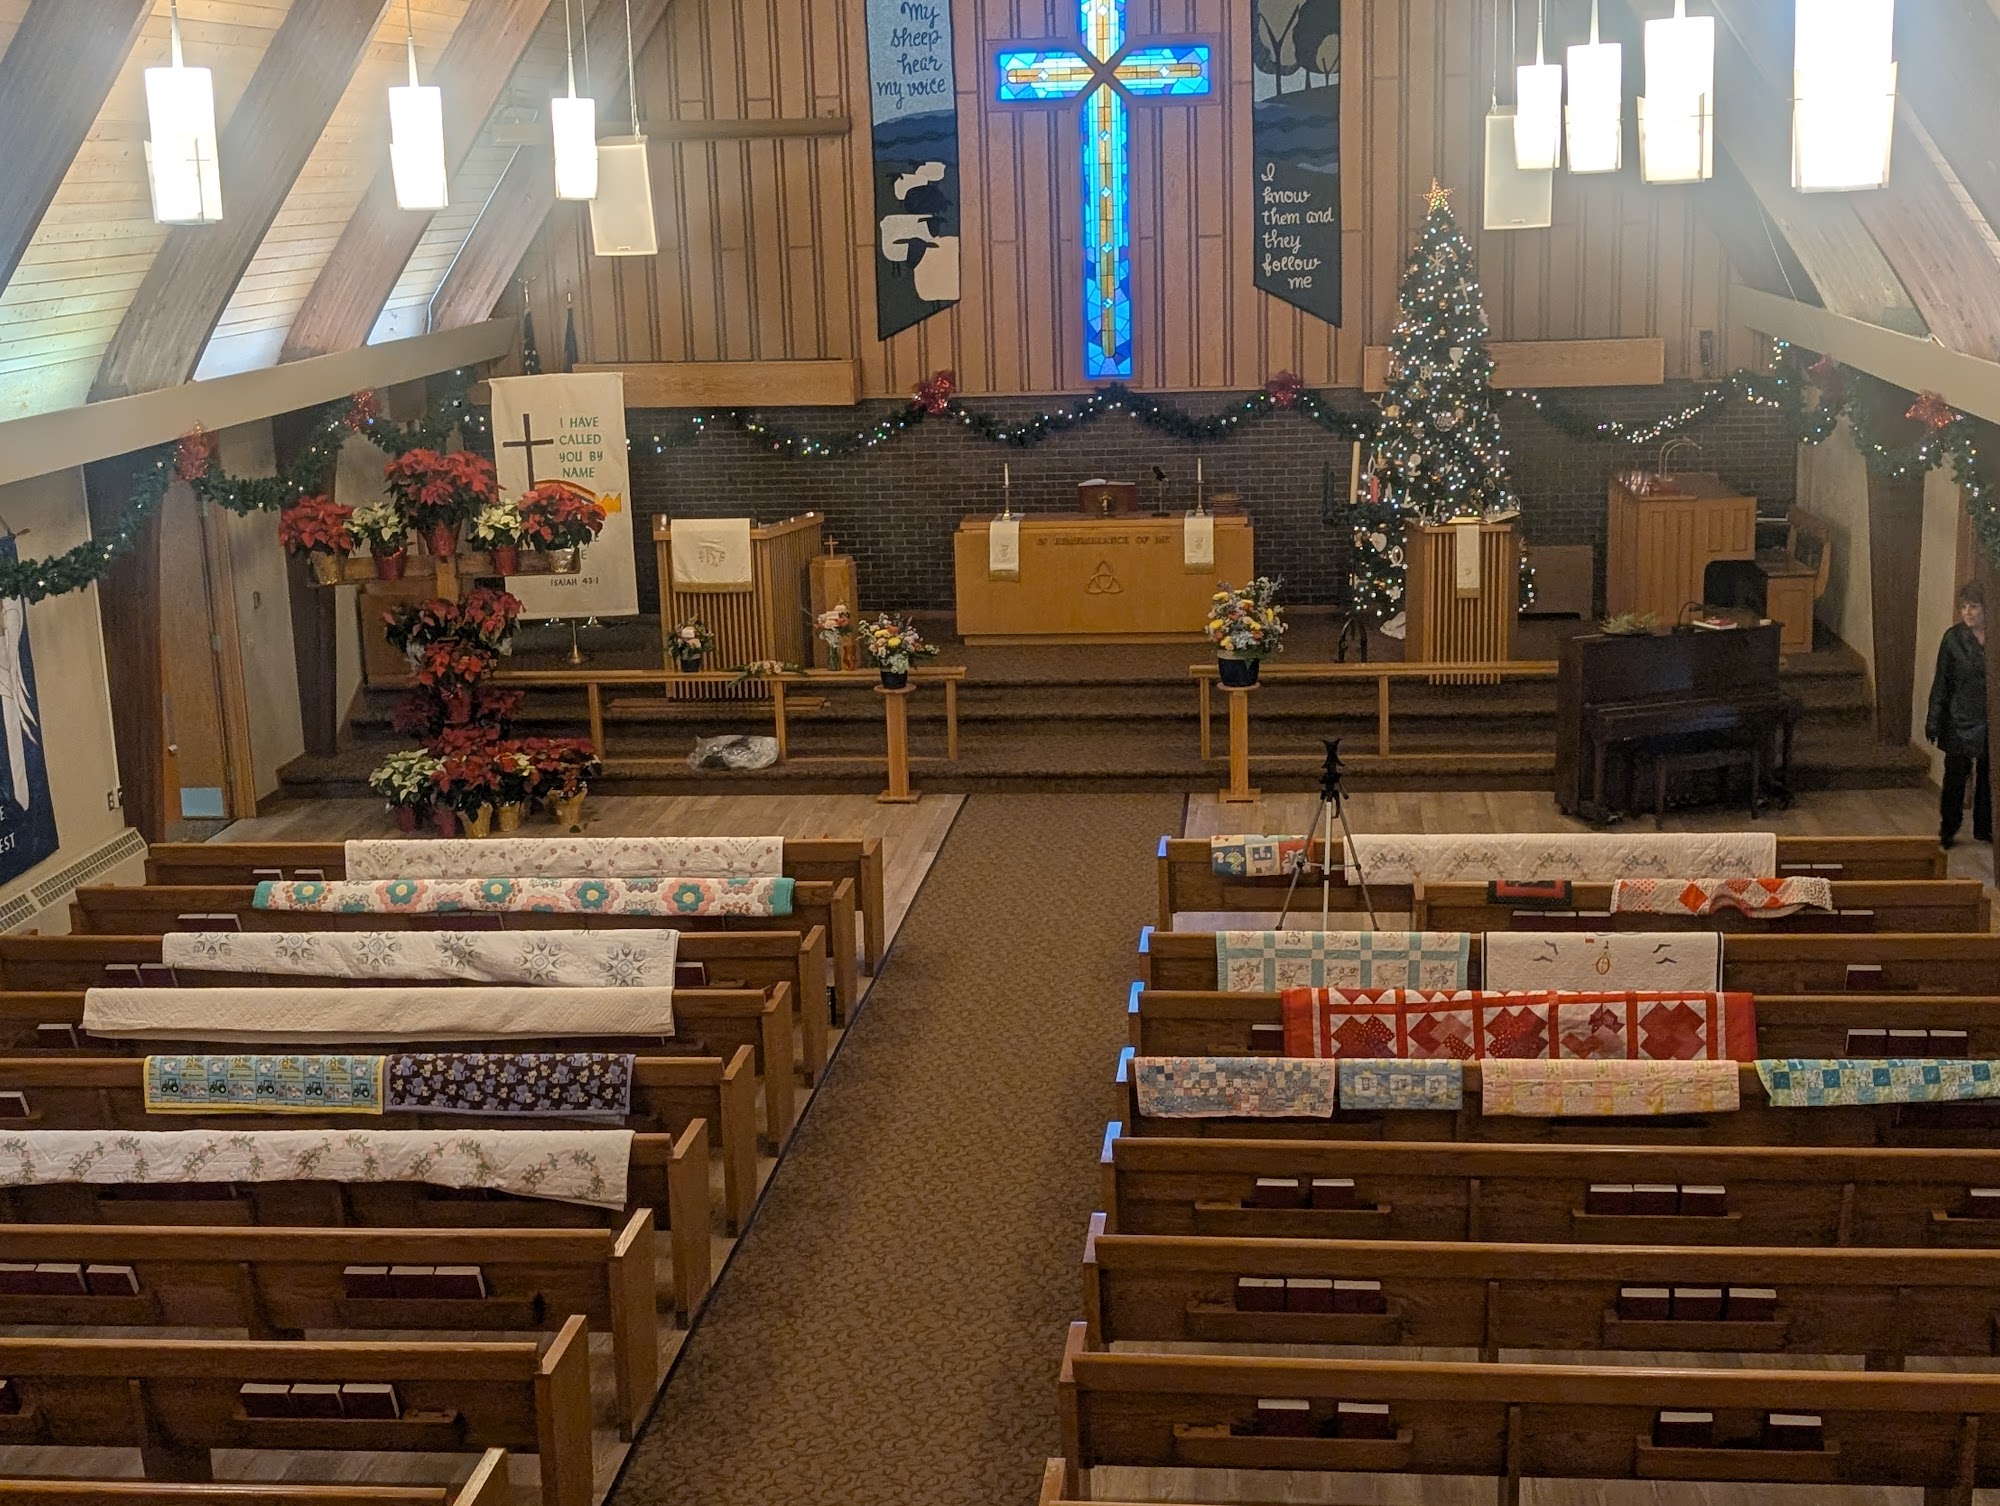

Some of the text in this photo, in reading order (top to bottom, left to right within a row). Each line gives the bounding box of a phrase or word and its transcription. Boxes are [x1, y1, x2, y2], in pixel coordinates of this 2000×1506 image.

[901, 1, 940, 29] My
[891, 27, 942, 52] sheep
[897, 53, 943, 75] hear
[877, 78, 946, 109] my voice
[1261, 162, 1275, 181] I
[1262, 186, 1311, 204] know
[1261, 207, 1334, 226] them and
[1262, 229, 1301, 254] they
[1262, 253, 1321, 277] follow
[1288, 276, 1312, 289] me
[569, 416, 599, 428] HAVE
[559, 433, 602, 446] CALLED
[559, 450, 603, 463] YOU BY
[562, 466, 596, 478] NAME
[550, 578, 578, 587] ISAIAH
